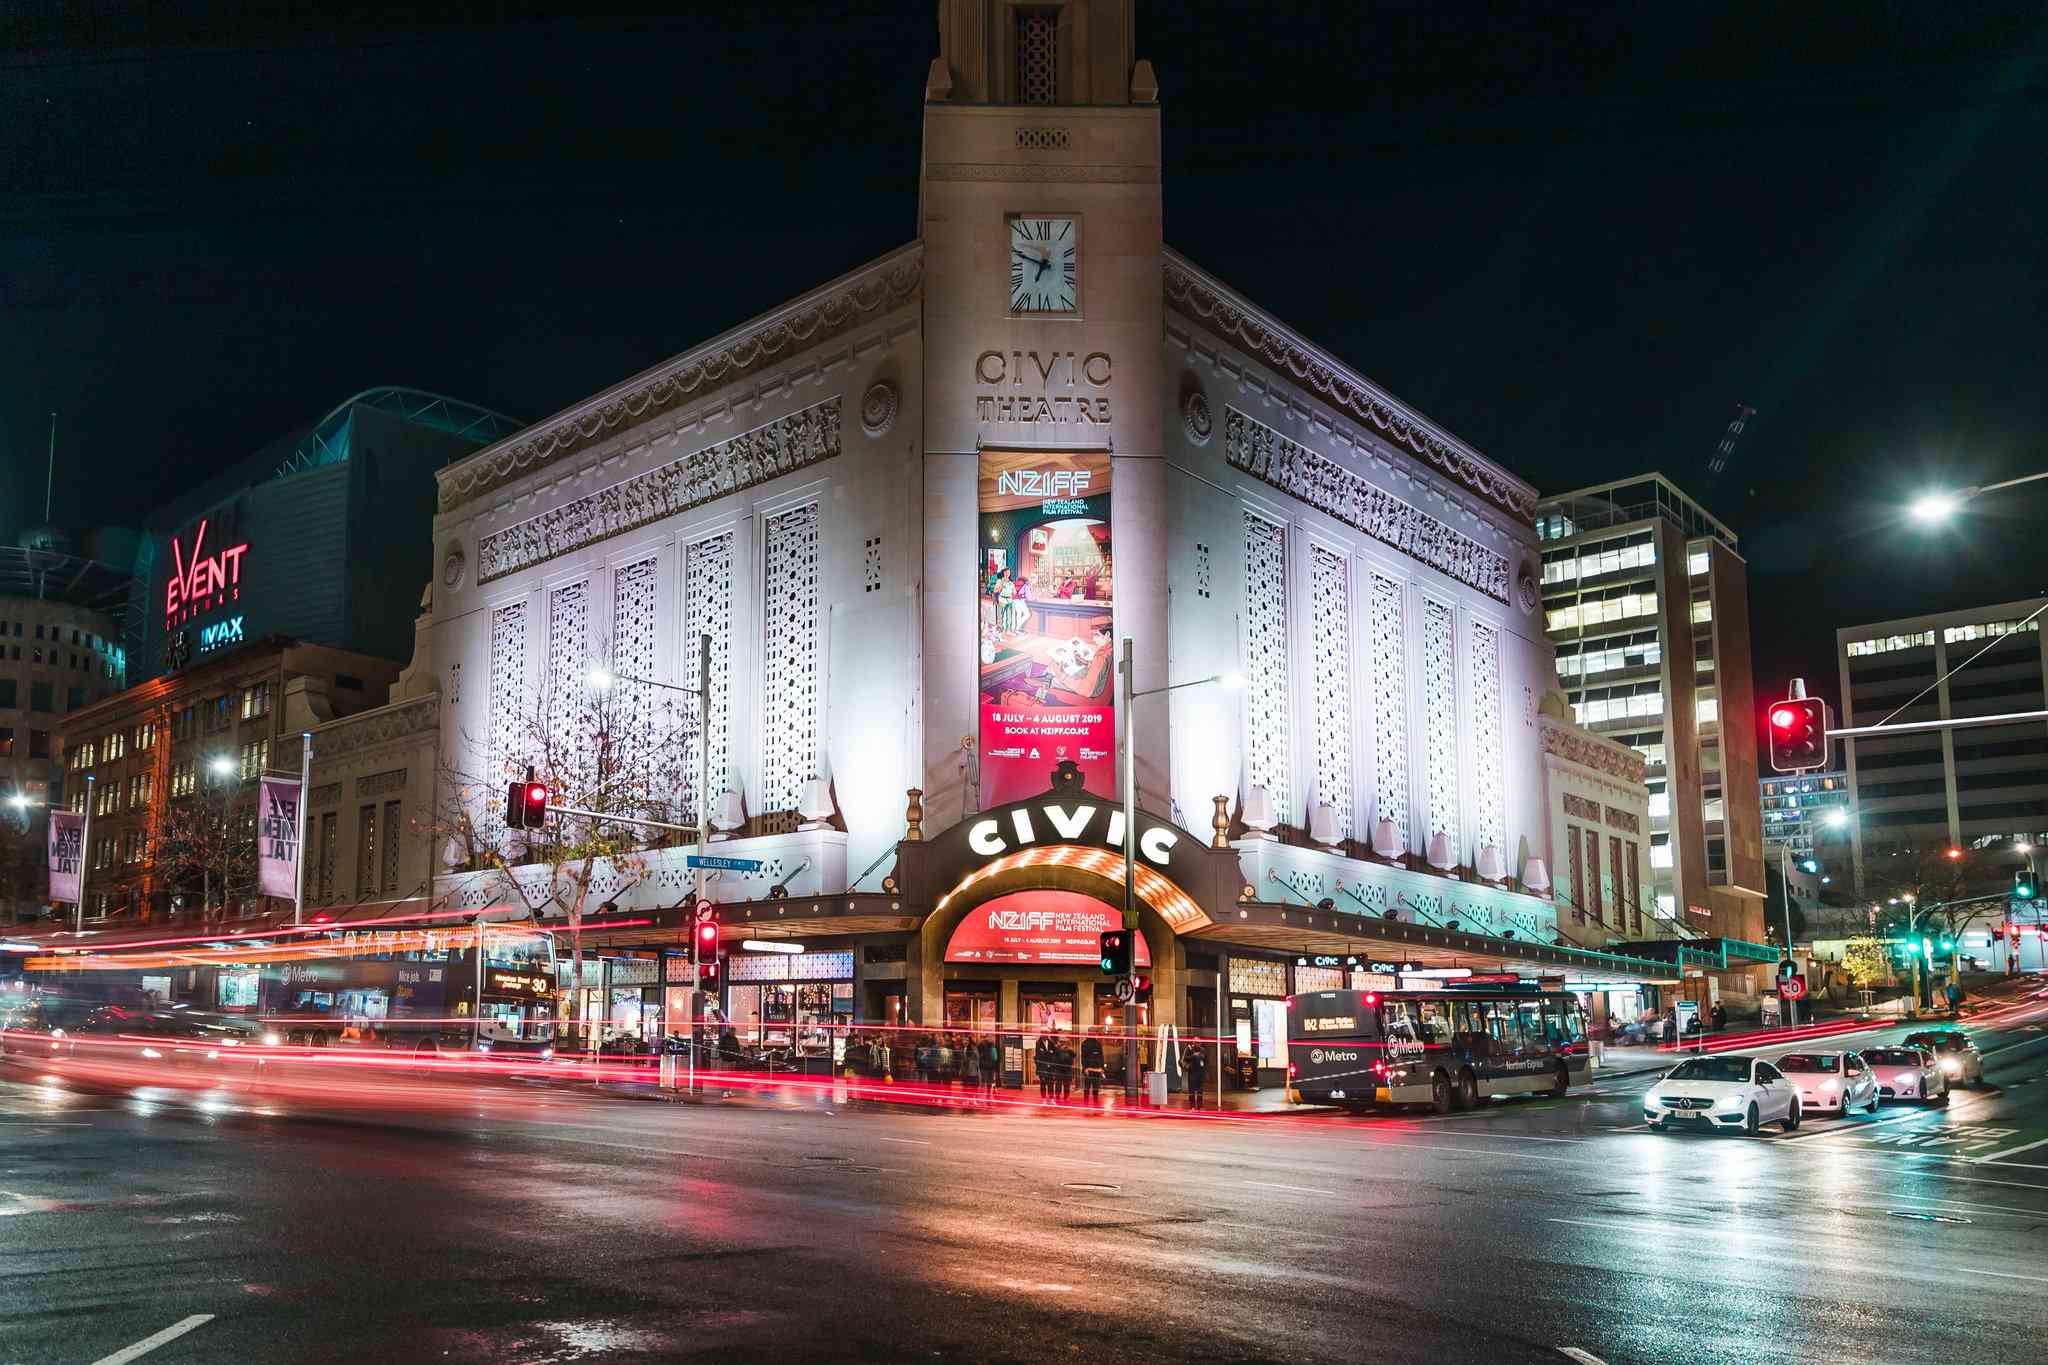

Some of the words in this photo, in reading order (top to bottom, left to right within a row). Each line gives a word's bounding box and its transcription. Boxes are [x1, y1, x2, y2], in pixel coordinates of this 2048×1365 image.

[976, 350, 1112, 389] CIVIC
[976, 396, 1113, 424] THEATRE
[998, 470, 1091, 496] NZIFF
[166, 519, 248, 615] EVENT
[201, 615, 243, 646] IMAX
[992, 713, 1001, 722] 18
[1003, 713, 1024, 722] JULY
[1033, 714, 1040, 723] 4
[1041, 714, 1080, 723] AUGUST
[1081, 714, 1102, 723] 2019
[1005, 727, 1028, 735] BOOK
[968, 805, 1178, 865] CIVIC
[699, 858, 730, 868] WELLESLEY
[989, 911, 1055, 931] NZIFF
[1056, 919, 1111, 927] INTERNATIONAL
[292, 966, 319, 982] Metro
[532, 978, 546, 992] 30
[1400, 1038, 1424, 1055] Metro
[1325, 1050, 1357, 1062] Metro
